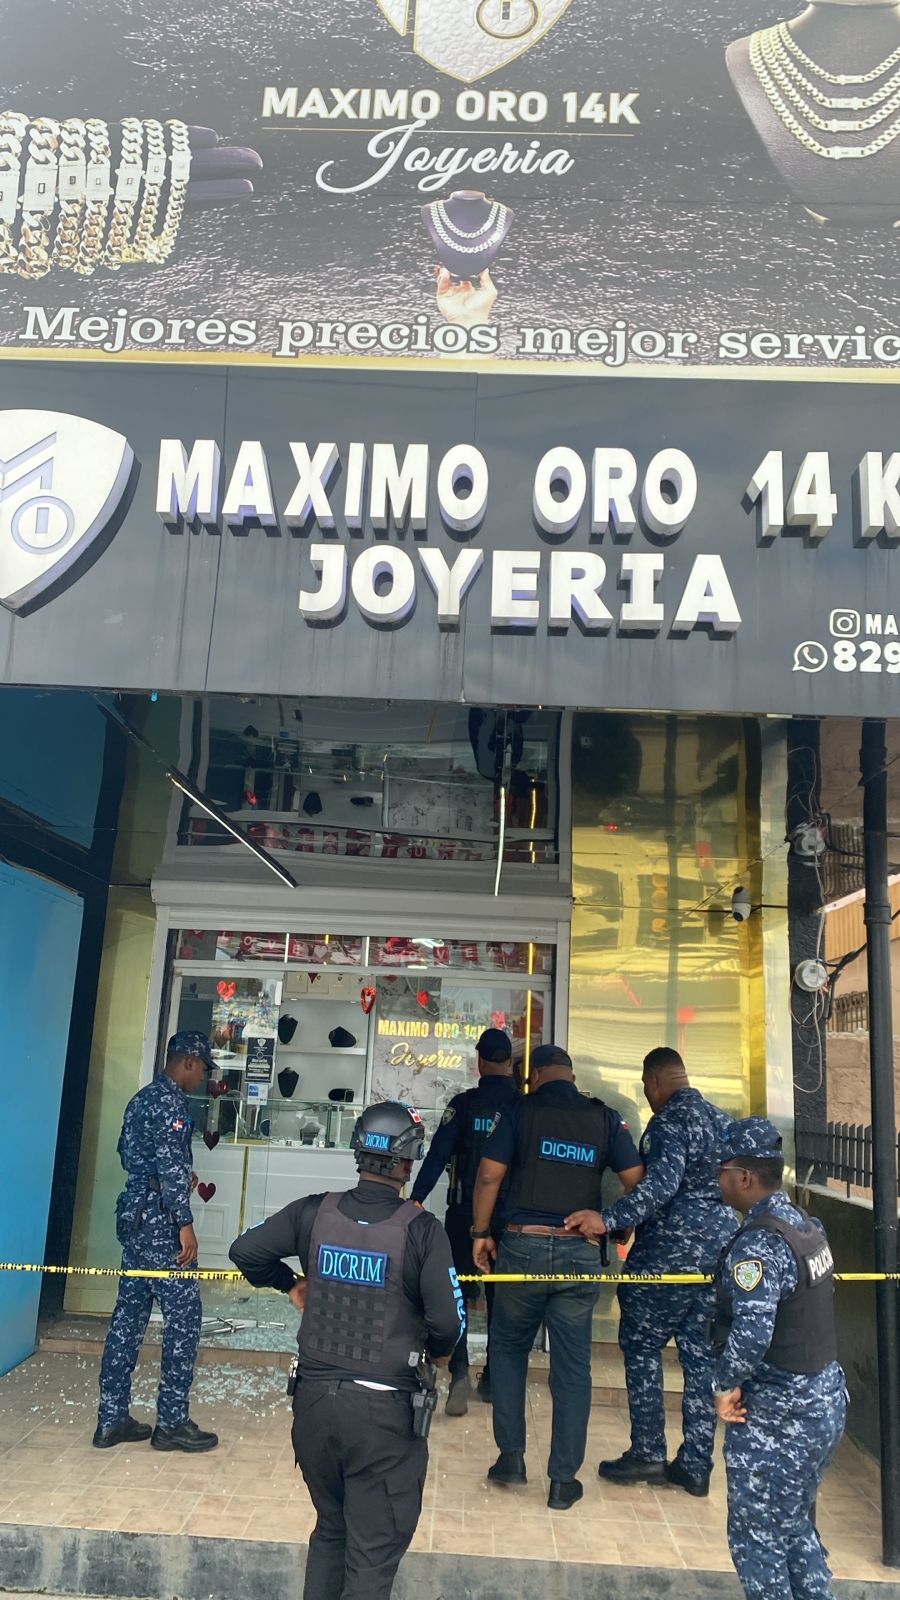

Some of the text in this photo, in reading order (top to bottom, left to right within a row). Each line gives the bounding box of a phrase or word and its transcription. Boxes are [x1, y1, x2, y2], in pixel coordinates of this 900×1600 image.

[262, 86, 641, 124] MAXIMO ORO 14K
[315, 119, 575, 194] Joyeria
[20, 305, 900, 366] Mejores precios mejor servic
[156, 438, 489, 531] MAXIMO
[533, 446, 698, 534] ORO
[745, 450, 838, 538] 14
[299, 543, 742, 631] JOYERIA
[865, 613, 899, 635] MA
[833, 639, 900, 674] 829
[377, 1019, 430, 1038] MAXIMO
[434, 1021, 460, 1039] ORO
[365, 1133, 390, 1149] DICRIM
[541, 1140, 595, 1163] DICRIM
[321, 1249, 384, 1282] DICRIM
